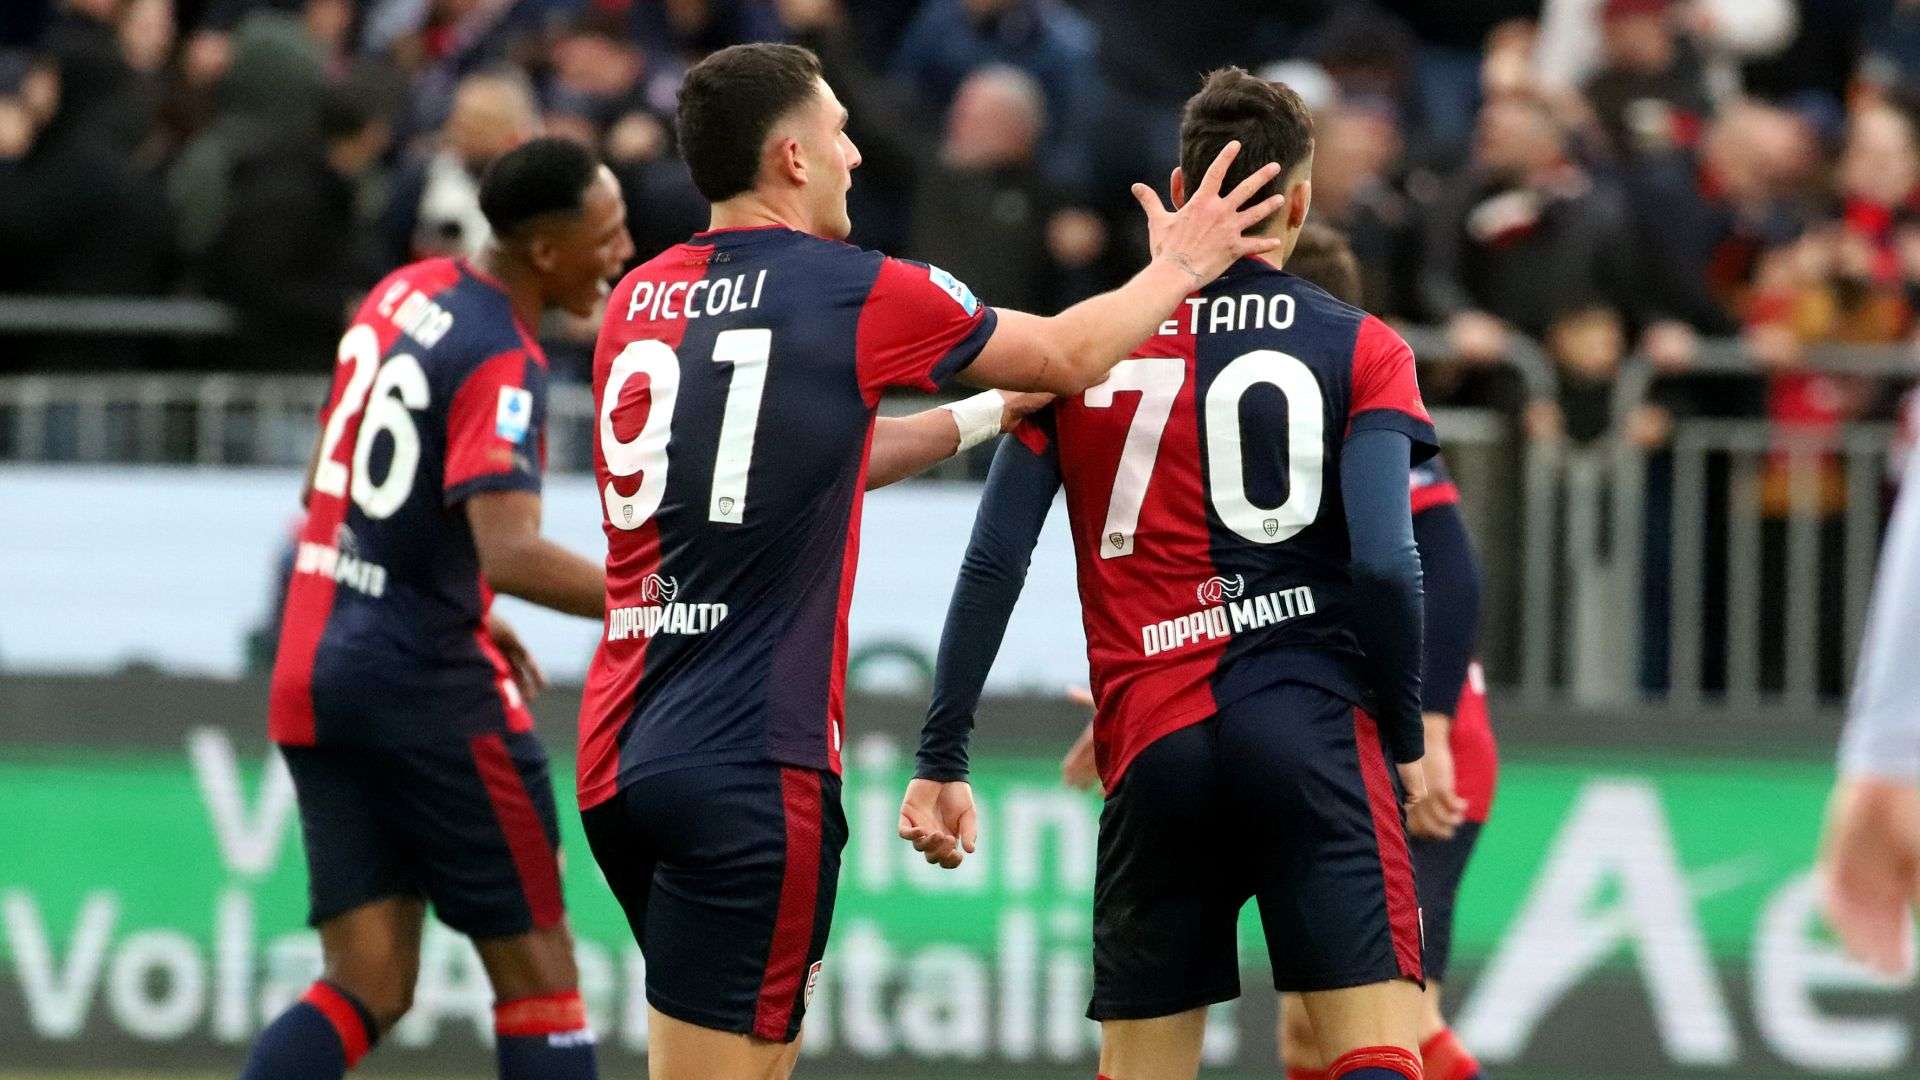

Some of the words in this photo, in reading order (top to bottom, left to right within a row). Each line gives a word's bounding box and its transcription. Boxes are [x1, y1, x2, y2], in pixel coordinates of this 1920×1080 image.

[626, 269, 768, 321] PICCOLI
[1158, 293, 1297, 336] TANO
[313, 323, 431, 520] 26
[600, 328, 772, 531] 91
[1084, 349, 1324, 560] 70
